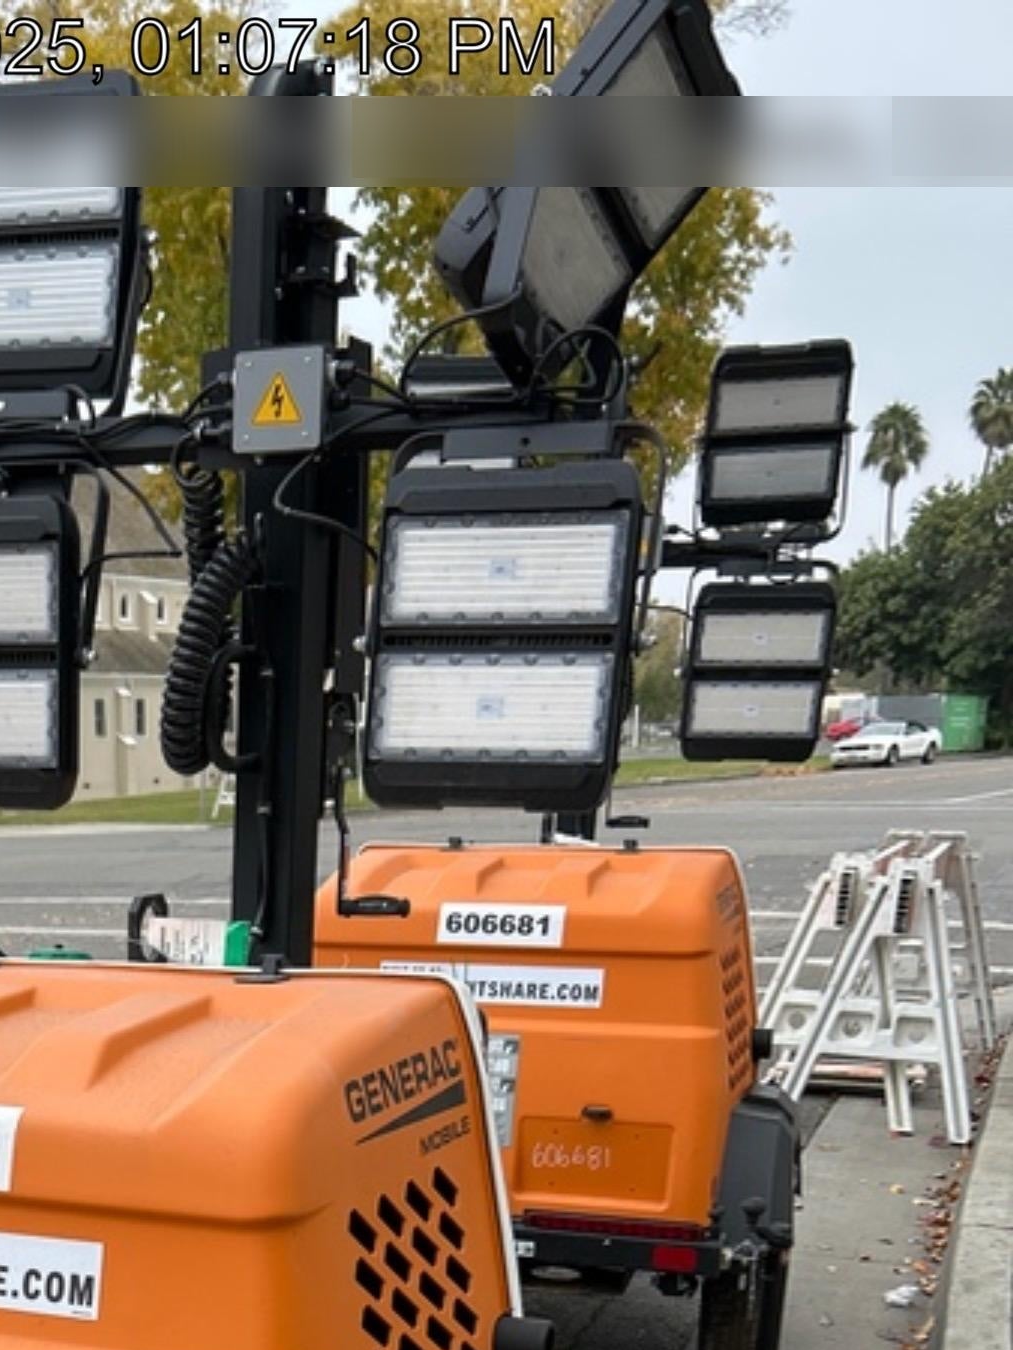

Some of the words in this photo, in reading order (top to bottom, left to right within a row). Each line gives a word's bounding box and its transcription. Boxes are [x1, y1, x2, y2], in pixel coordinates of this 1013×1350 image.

[445, 912, 550, 936] 606681
[343, 1038, 462, 1124] GENERAC
[419, 1114, 471, 1156] MOBILE
[532, 1142, 611, 1171] 606681
